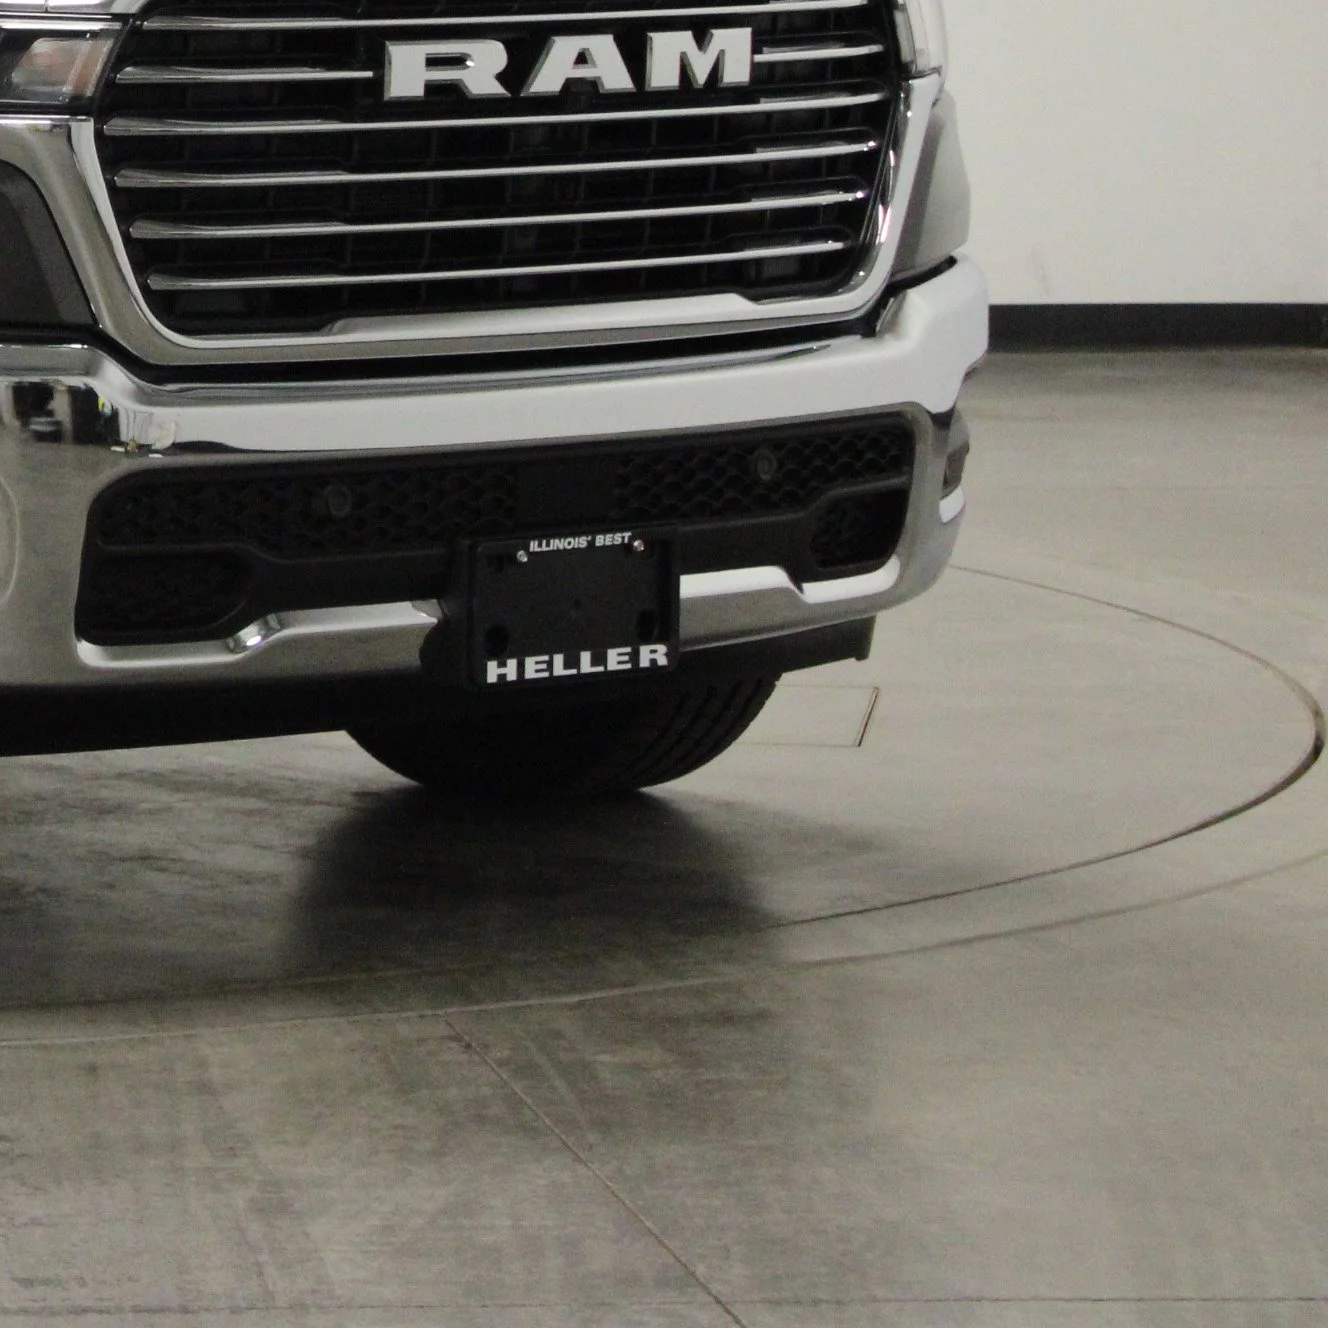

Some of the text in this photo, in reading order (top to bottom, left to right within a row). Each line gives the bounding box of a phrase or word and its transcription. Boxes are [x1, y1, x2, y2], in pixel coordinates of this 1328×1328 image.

[383, 27, 753, 101] RAM
[529, 531, 633, 553] ILLINOIS' BEST
[486, 644, 668, 684] HELLER
